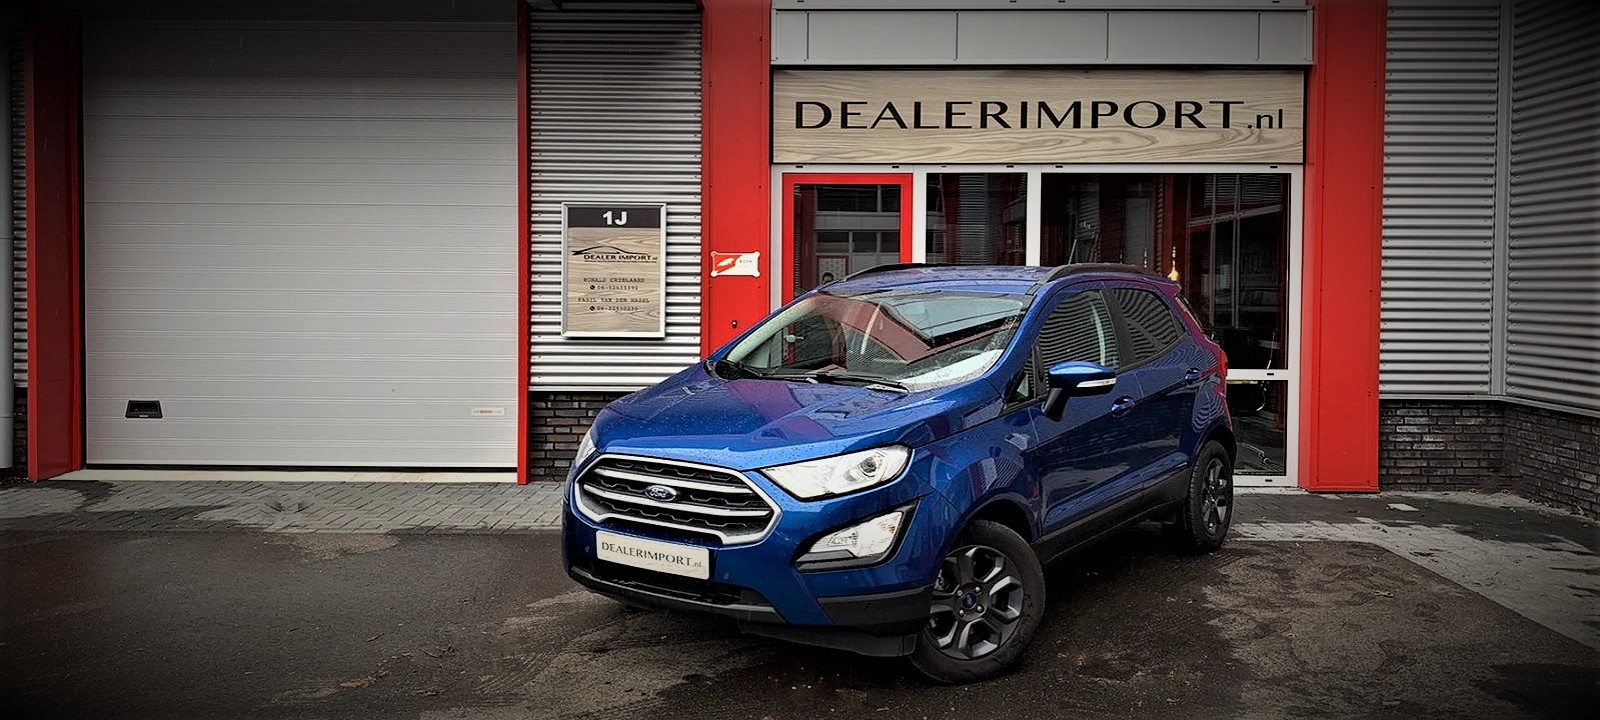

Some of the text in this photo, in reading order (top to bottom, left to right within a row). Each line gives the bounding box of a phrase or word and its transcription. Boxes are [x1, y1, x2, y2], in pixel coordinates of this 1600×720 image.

[794, 100, 1284, 130] DEALERIMPORT.nl
[602, 210, 628, 226] 1J
[601, 541, 702, 568] DEALERIMPORT.nl
